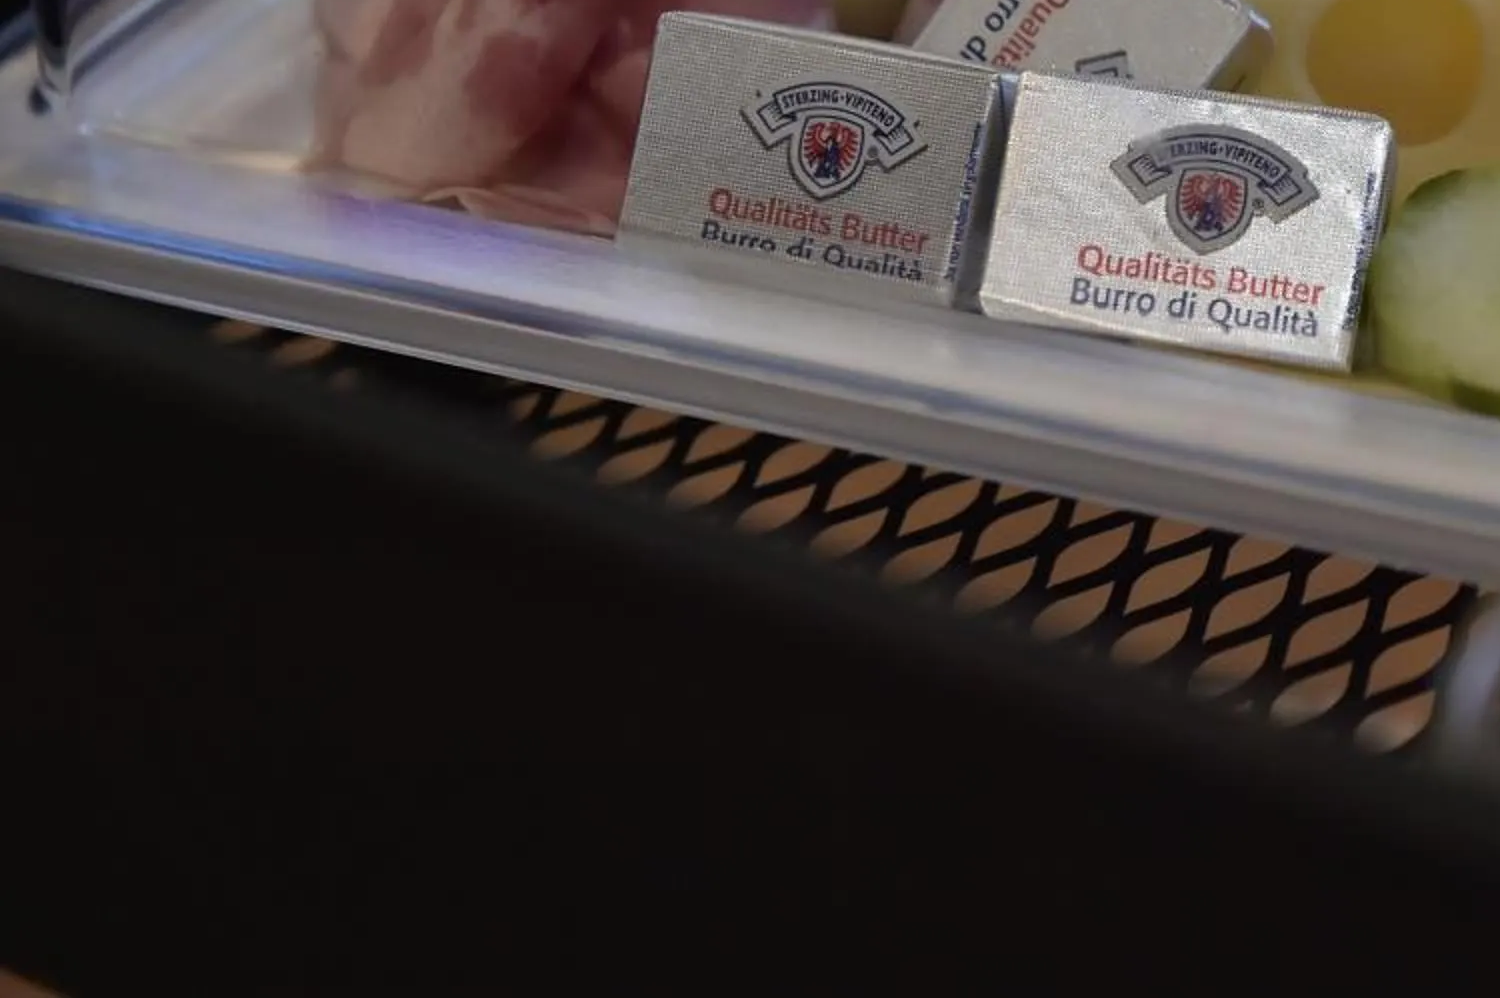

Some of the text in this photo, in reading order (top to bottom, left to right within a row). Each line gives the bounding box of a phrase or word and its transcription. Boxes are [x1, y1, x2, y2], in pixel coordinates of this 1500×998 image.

[701, 220, 777, 252] Burro
[786, 236, 813, 259] di
[709, 188, 932, 255] Qualitäts Butter
[1077, 244, 1325, 305] Qualitäts Butter
[1070, 277, 1319, 337] Burro di Qualità
